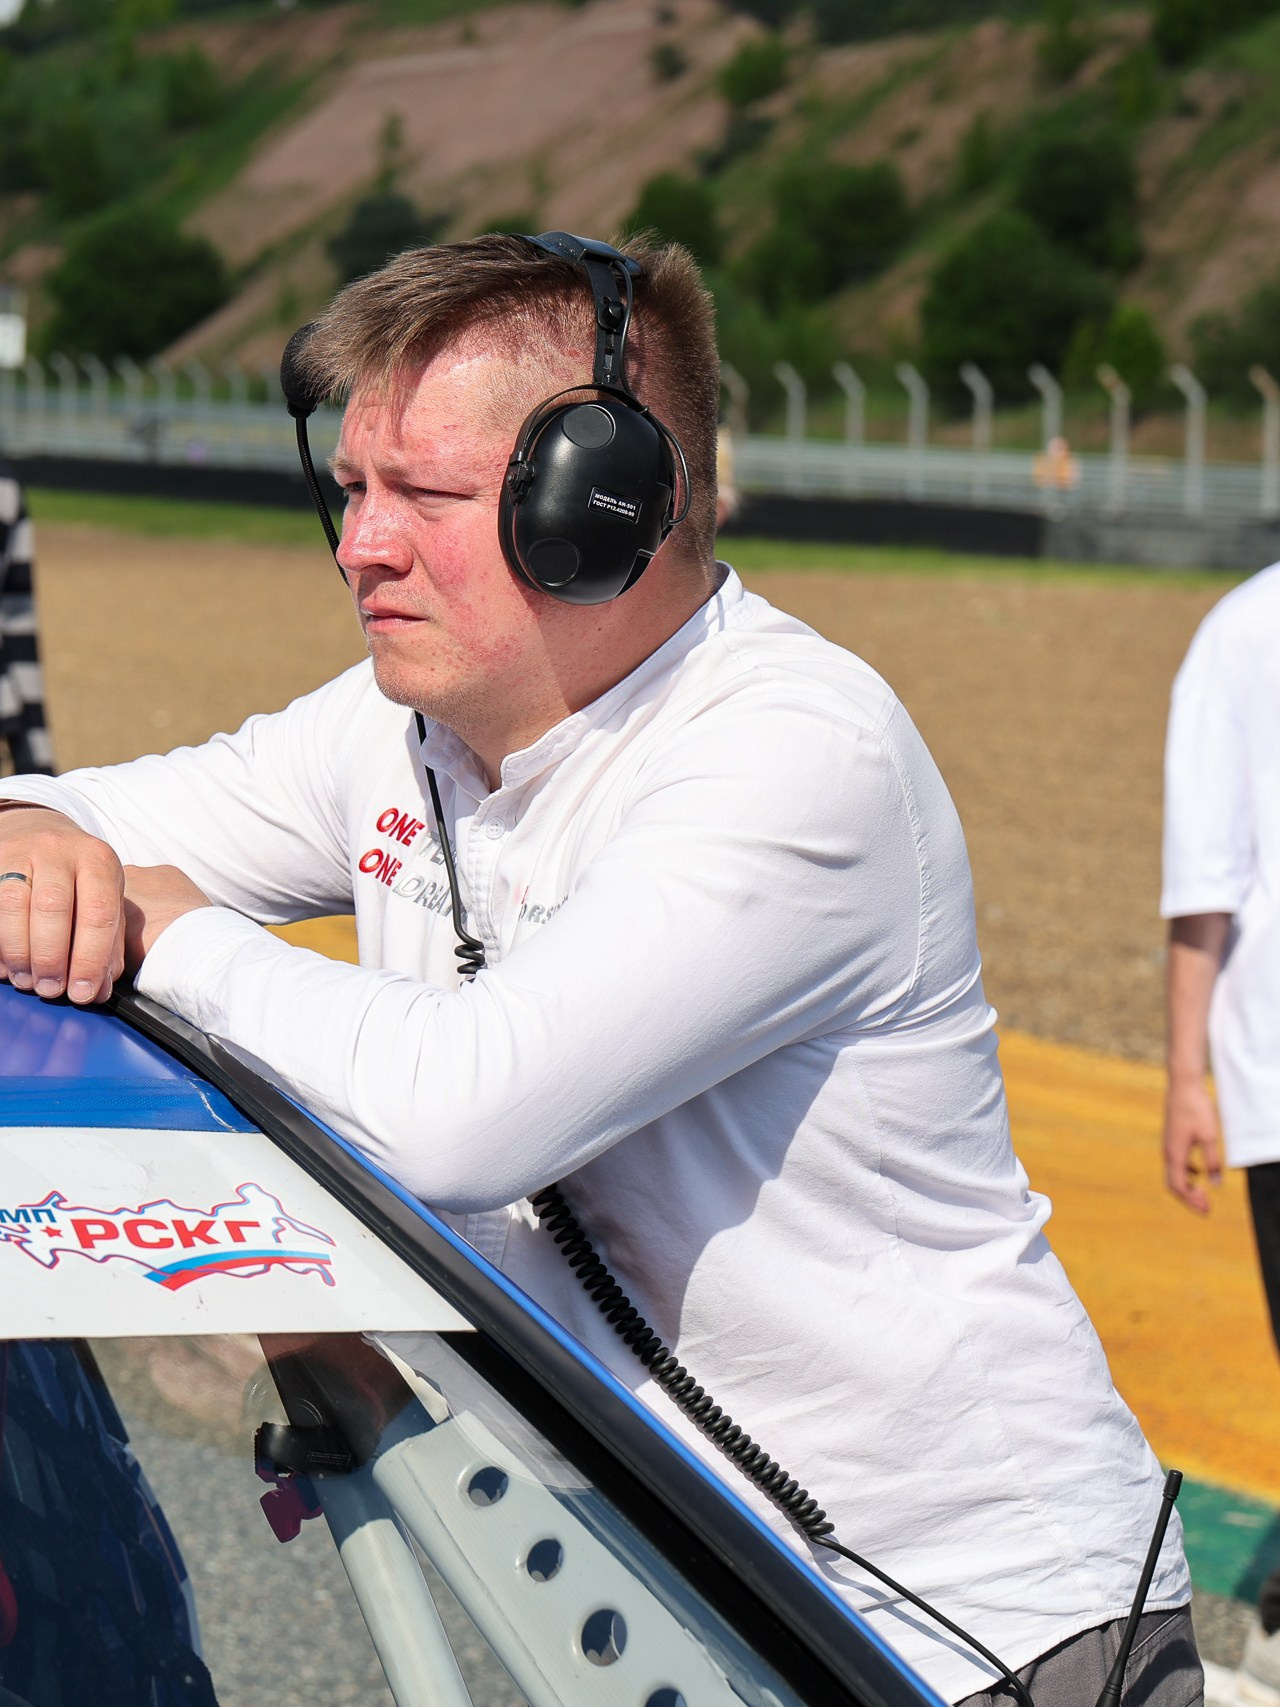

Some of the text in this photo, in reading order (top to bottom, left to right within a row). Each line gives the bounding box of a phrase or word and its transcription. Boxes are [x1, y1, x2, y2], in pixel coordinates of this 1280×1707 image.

[592, 499, 607, 508] ГОСТ
[376, 808, 425, 846] ONE
[358, 848, 403, 886] ONE
[70, 1218, 261, 1250] РСКГ
